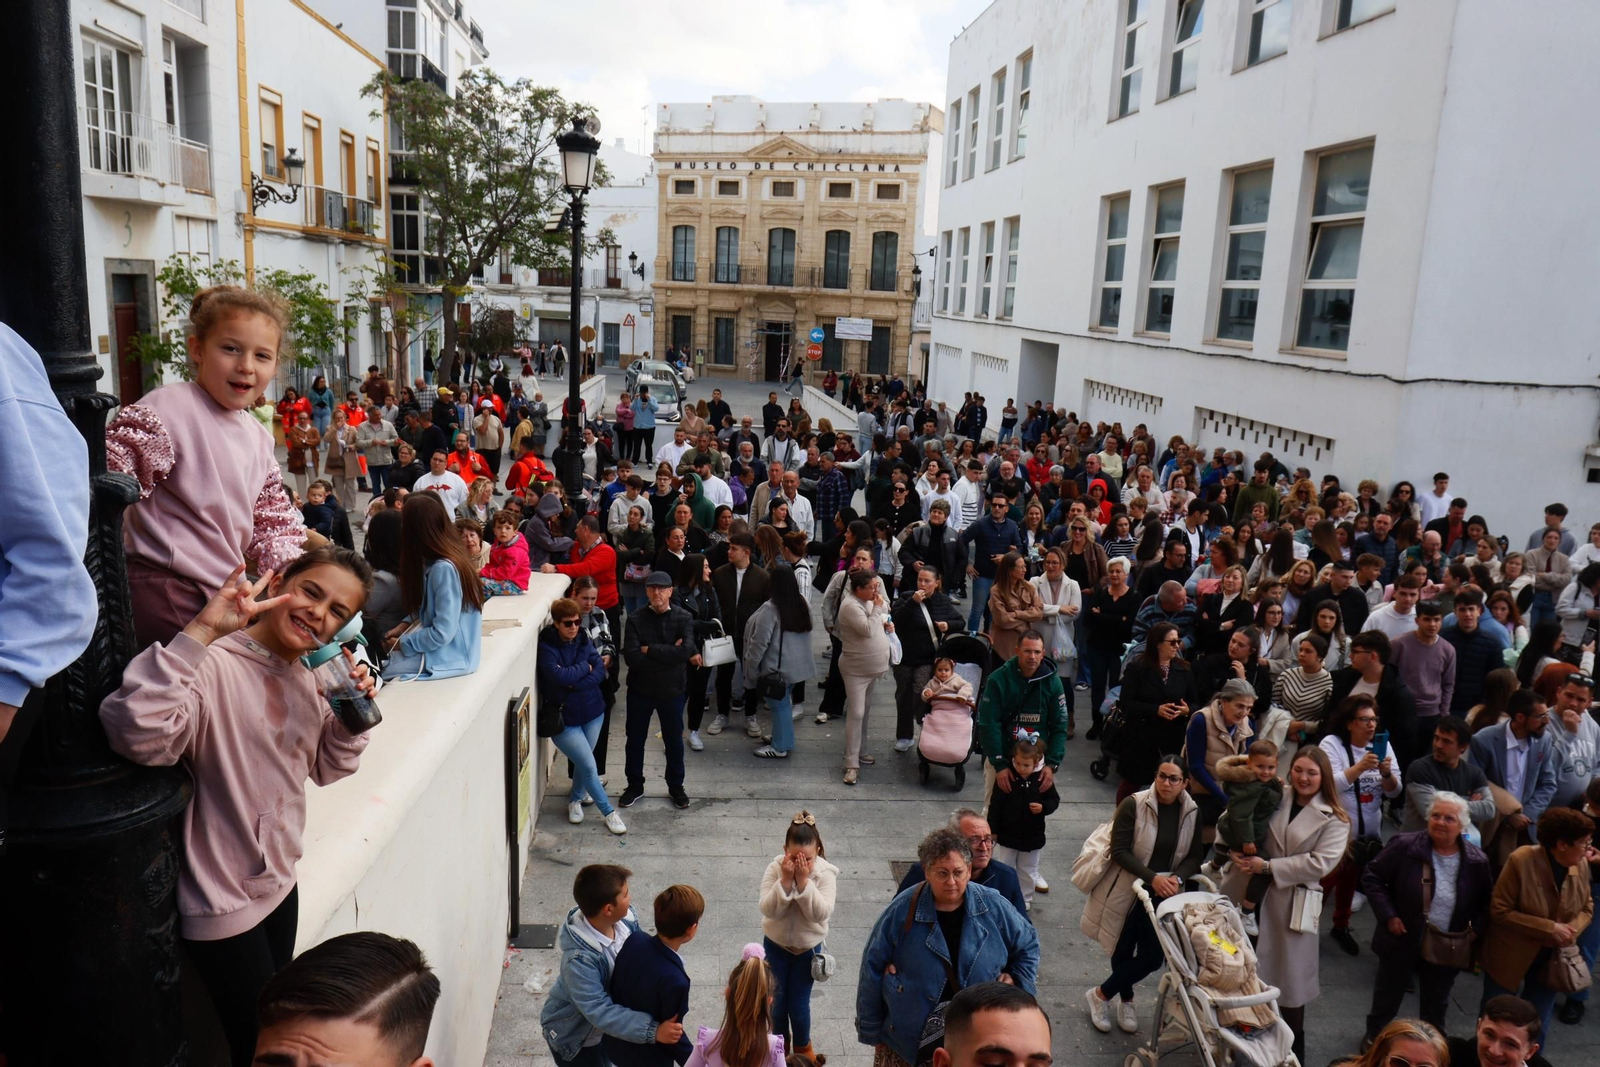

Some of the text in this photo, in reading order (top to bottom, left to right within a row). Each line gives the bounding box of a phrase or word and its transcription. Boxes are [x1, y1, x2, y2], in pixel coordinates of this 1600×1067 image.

[674, 161, 901, 173] MUSEO DE CHICLANA
[122, 210, 133, 248] 3
